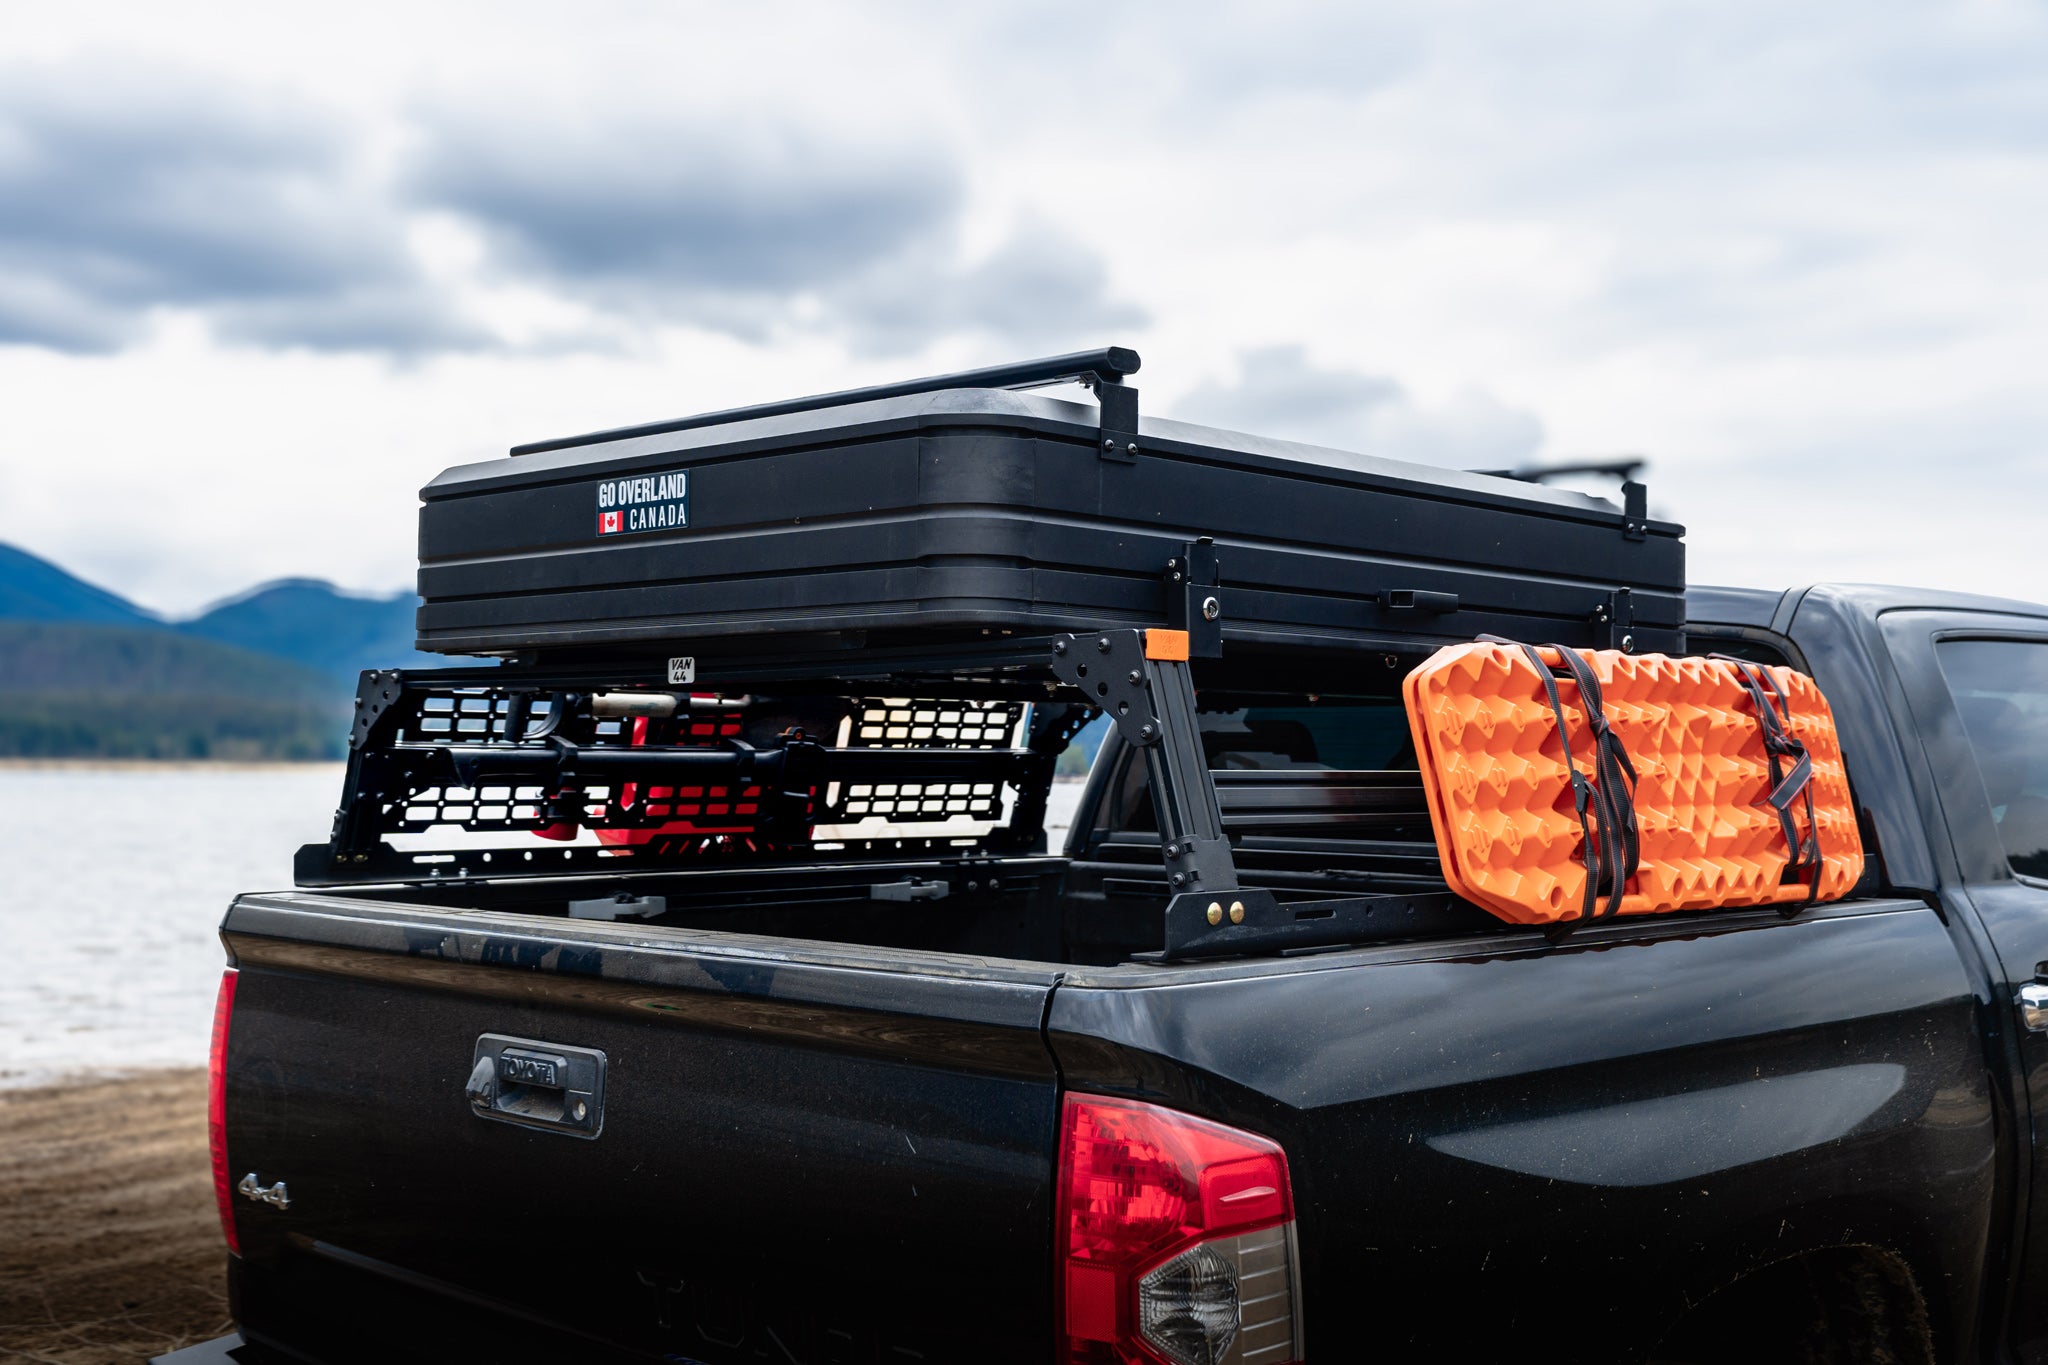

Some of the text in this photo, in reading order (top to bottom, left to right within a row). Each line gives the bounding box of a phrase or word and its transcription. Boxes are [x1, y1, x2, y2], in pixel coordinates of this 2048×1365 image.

[599, 474, 686, 508] GO OVERLAND
[630, 504, 686, 530] CANADA
[672, 659, 692, 670] VAN
[673, 671, 686, 682] 44
[500, 1056, 556, 1085] TOYOTA
